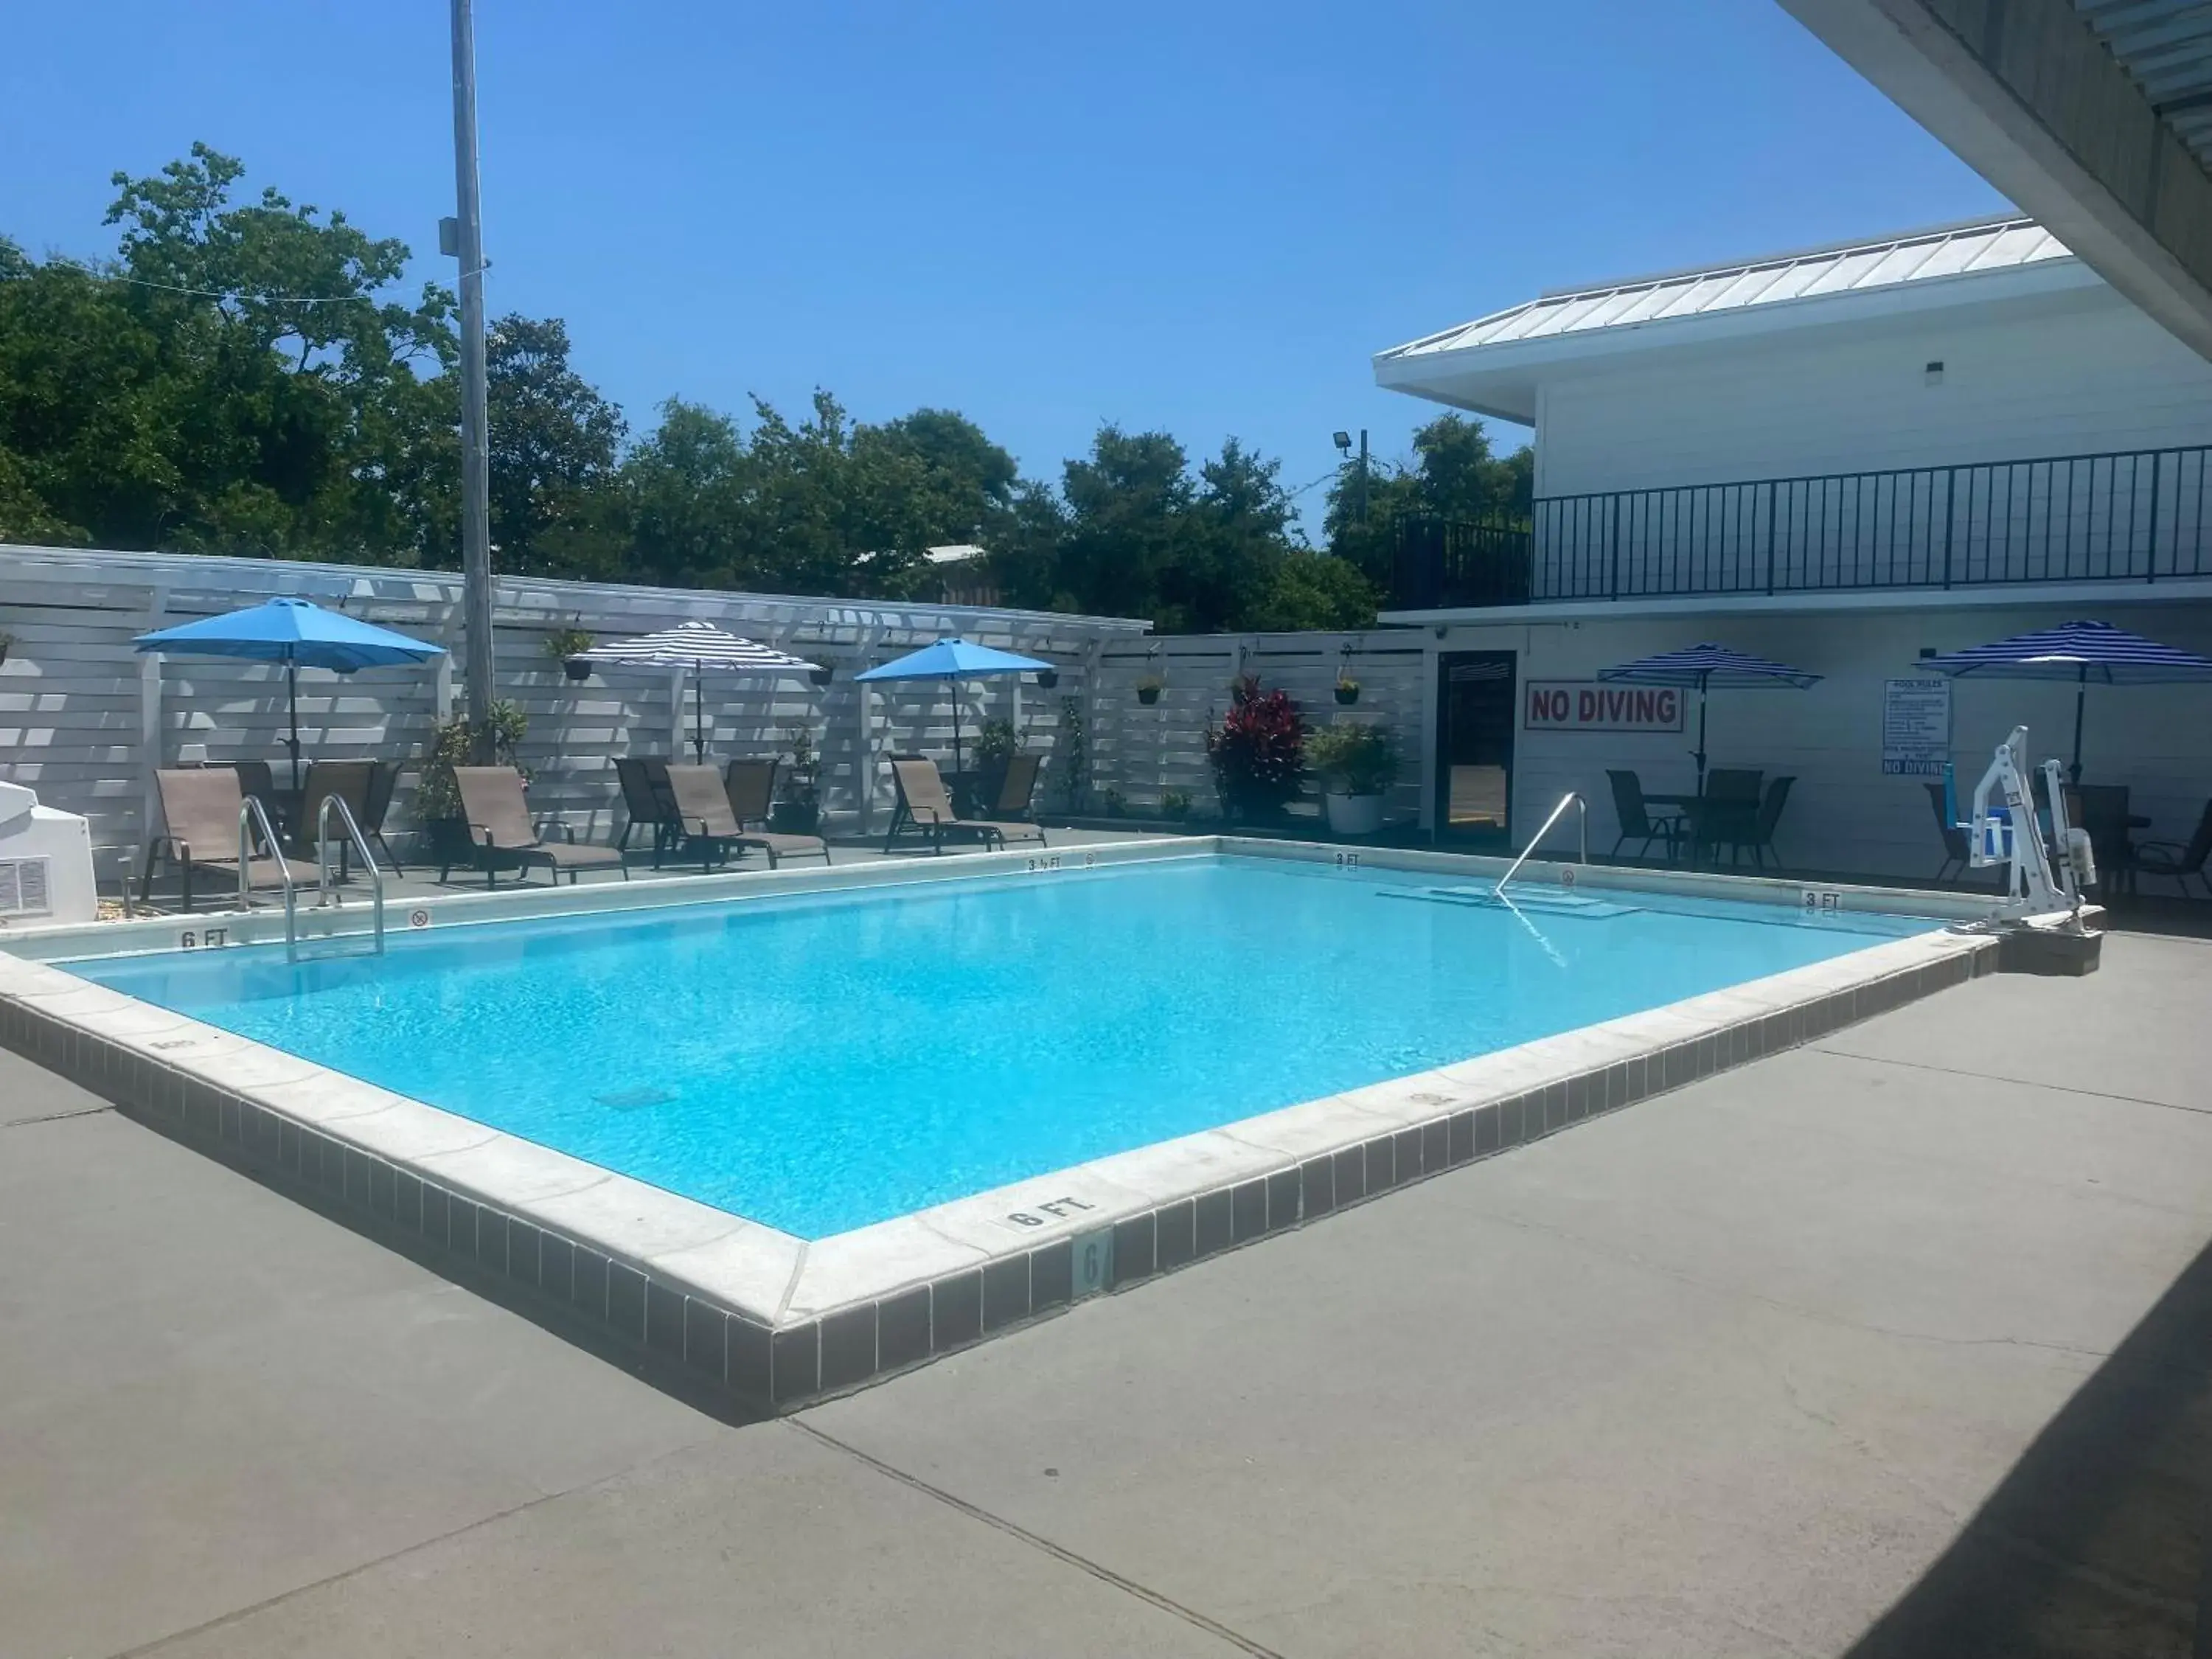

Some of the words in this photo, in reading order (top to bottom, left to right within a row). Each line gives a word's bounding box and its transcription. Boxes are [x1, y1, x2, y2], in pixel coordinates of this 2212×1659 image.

[1531, 689, 1570, 722] NO
[1578, 689, 1677, 723] DIVING
[1884, 760, 1900, 773] NO
[1029, 860, 1034, 871] 3
[1051, 857, 1061, 868] FT
[1337, 853, 1343, 864] 3
[1347, 854, 1358, 865] FT
[1806, 892, 1815, 906] 3
[1822, 893, 1840, 908] FT
[181, 931, 195, 947] 6
[205, 928, 228, 947] FT
[1038, 1197, 1096, 1217] FT
